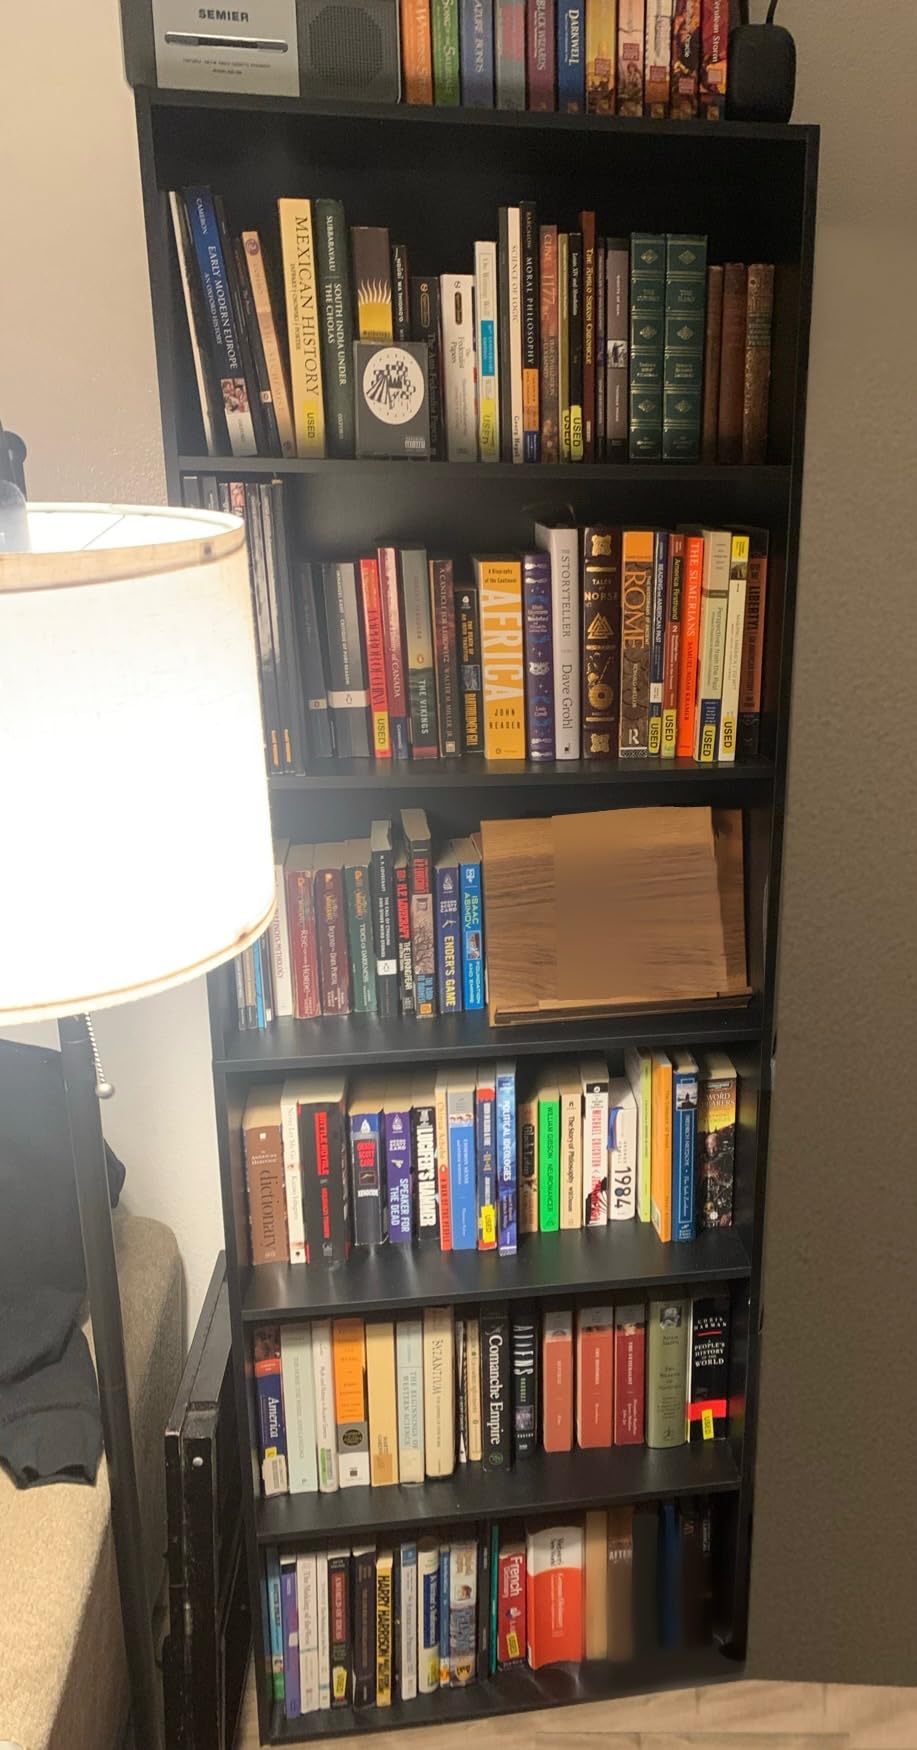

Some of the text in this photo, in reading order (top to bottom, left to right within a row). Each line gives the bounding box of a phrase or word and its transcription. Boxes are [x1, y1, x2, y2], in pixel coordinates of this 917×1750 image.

[198, 8, 250, 23] SEMIER
[567, 9, 580, 66] DARKWELL
[711, 35, 722, 63] Storm
[195, 197, 208, 235] CAMERON
[325, 215, 336, 272] SUBBARAYALU
[585, 247, 593, 265] THE
[525, 256, 534, 294] MORAL
[542, 273, 554, 304] 1177
[585, 266, 593, 294] ANGLO
[206, 246, 239, 370] EARLY MODERN EUROPE
[294, 216, 320, 397] MEXICAN HISTORY
[324, 282, 336, 344] THE CHOLAS
[332, 282, 347, 385] SOUTH INDIA UNDER
[526, 297, 535, 365] PHILOSOPHY
[585, 323, 593, 365] CHRONICLE
[306, 411, 316, 439] USED
[572, 416, 581, 448] USED
[560, 555, 571, 638] STORYTELLER
[623, 570, 646, 649] ROME
[672, 558, 681, 621] America Firsthand
[686, 543, 701, 637] THE SUMERIANS
[480, 590, 523, 701] AFRICA
[392, 662, 401, 698] CANADA
[712, 664, 721, 676] the
[419, 679, 429, 734] THE VIKINGS
[494, 708, 516, 717] JOHN
[561, 664, 574, 729] Dave Grohl
[376, 717, 386, 745] USED
[650, 722, 659, 749] USED
[664, 714, 674, 742] USED
[702, 729, 713, 757] USED
[723, 720, 734, 749] USED
[398, 899, 410, 939] LOVECRAFT
[463, 892, 472, 929] ASIMOV
[471, 895, 479, 924] ISAAC
[443, 935, 457, 1007] ENDER'S GAME
[503, 1100, 512, 1182] POLITICAL IDEOLOGIES
[566, 1127, 575, 1142] Story
[568, 1142, 575, 1150] of
[416, 1127, 437, 1228] LUCIFER'S HAMMER
[546, 1106, 554, 1213] WILLIAM GIBSON NEUROMANCER
[566, 1151, 575, 1184] Philosophy
[389, 1185, 400, 1226] THE DEAD
[399, 1178, 411, 1233] SPEAKER FOR
[614, 1165, 632, 1209] 1984
[258, 1170, 279, 1250] dictionary
[694, 1342, 725, 1350] PEOPLE'S
[695, 1349, 724, 1357] HISTORY
[695, 1358, 725, 1367] WORLD
[486, 1334, 504, 1445] Comanche Empire
[268, 1396, 281, 1438] America
[377, 1575, 390, 1608] HARRY
[509, 1556, 522, 1597] French
[378, 1609, 391, 1658] HARRISON
